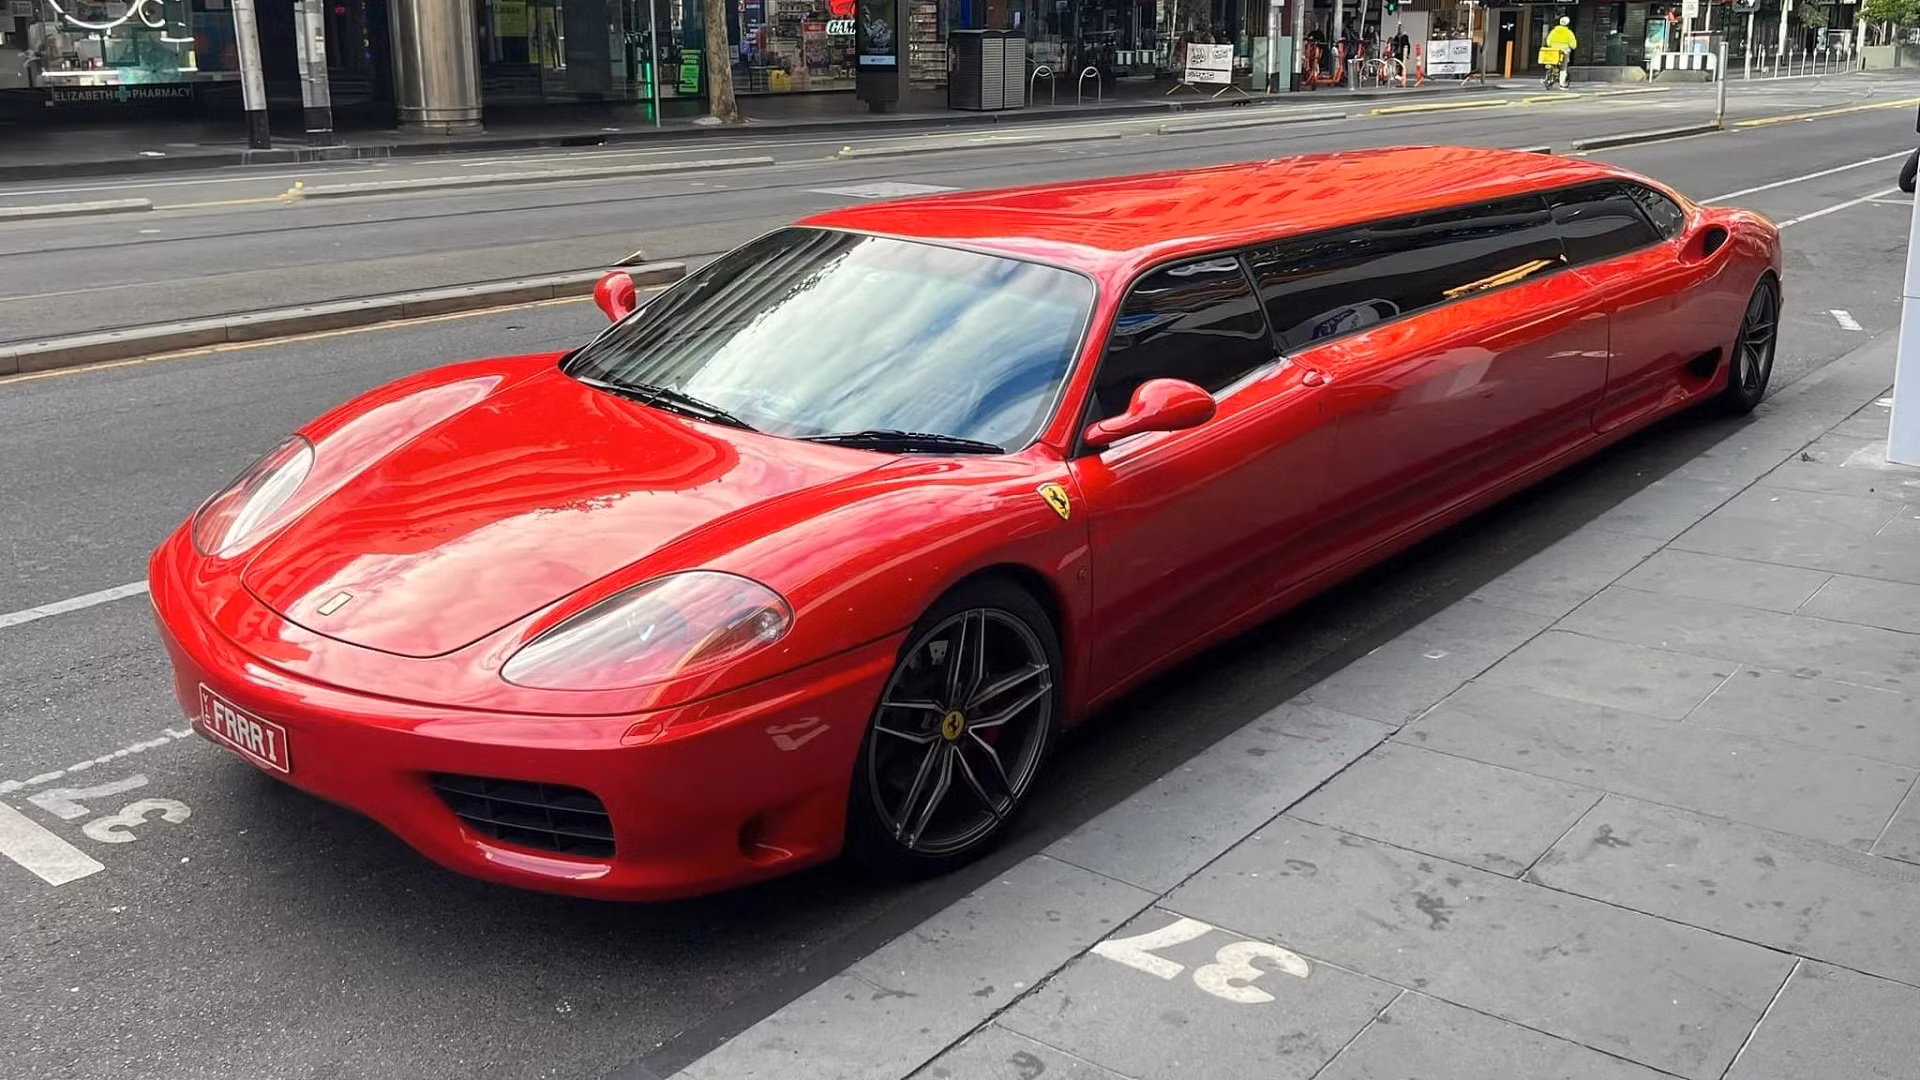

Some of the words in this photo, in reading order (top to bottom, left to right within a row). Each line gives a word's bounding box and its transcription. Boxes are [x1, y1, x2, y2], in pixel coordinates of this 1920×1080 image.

[54, 90, 114, 102] ELIZABETH
[132, 87, 191, 100] PHARMACY
[202, 693, 211, 724] VIC
[213, 699, 277, 762] FRRRI
[26, 774, 192, 844] 37
[1089, 917, 1310, 1004] 37
